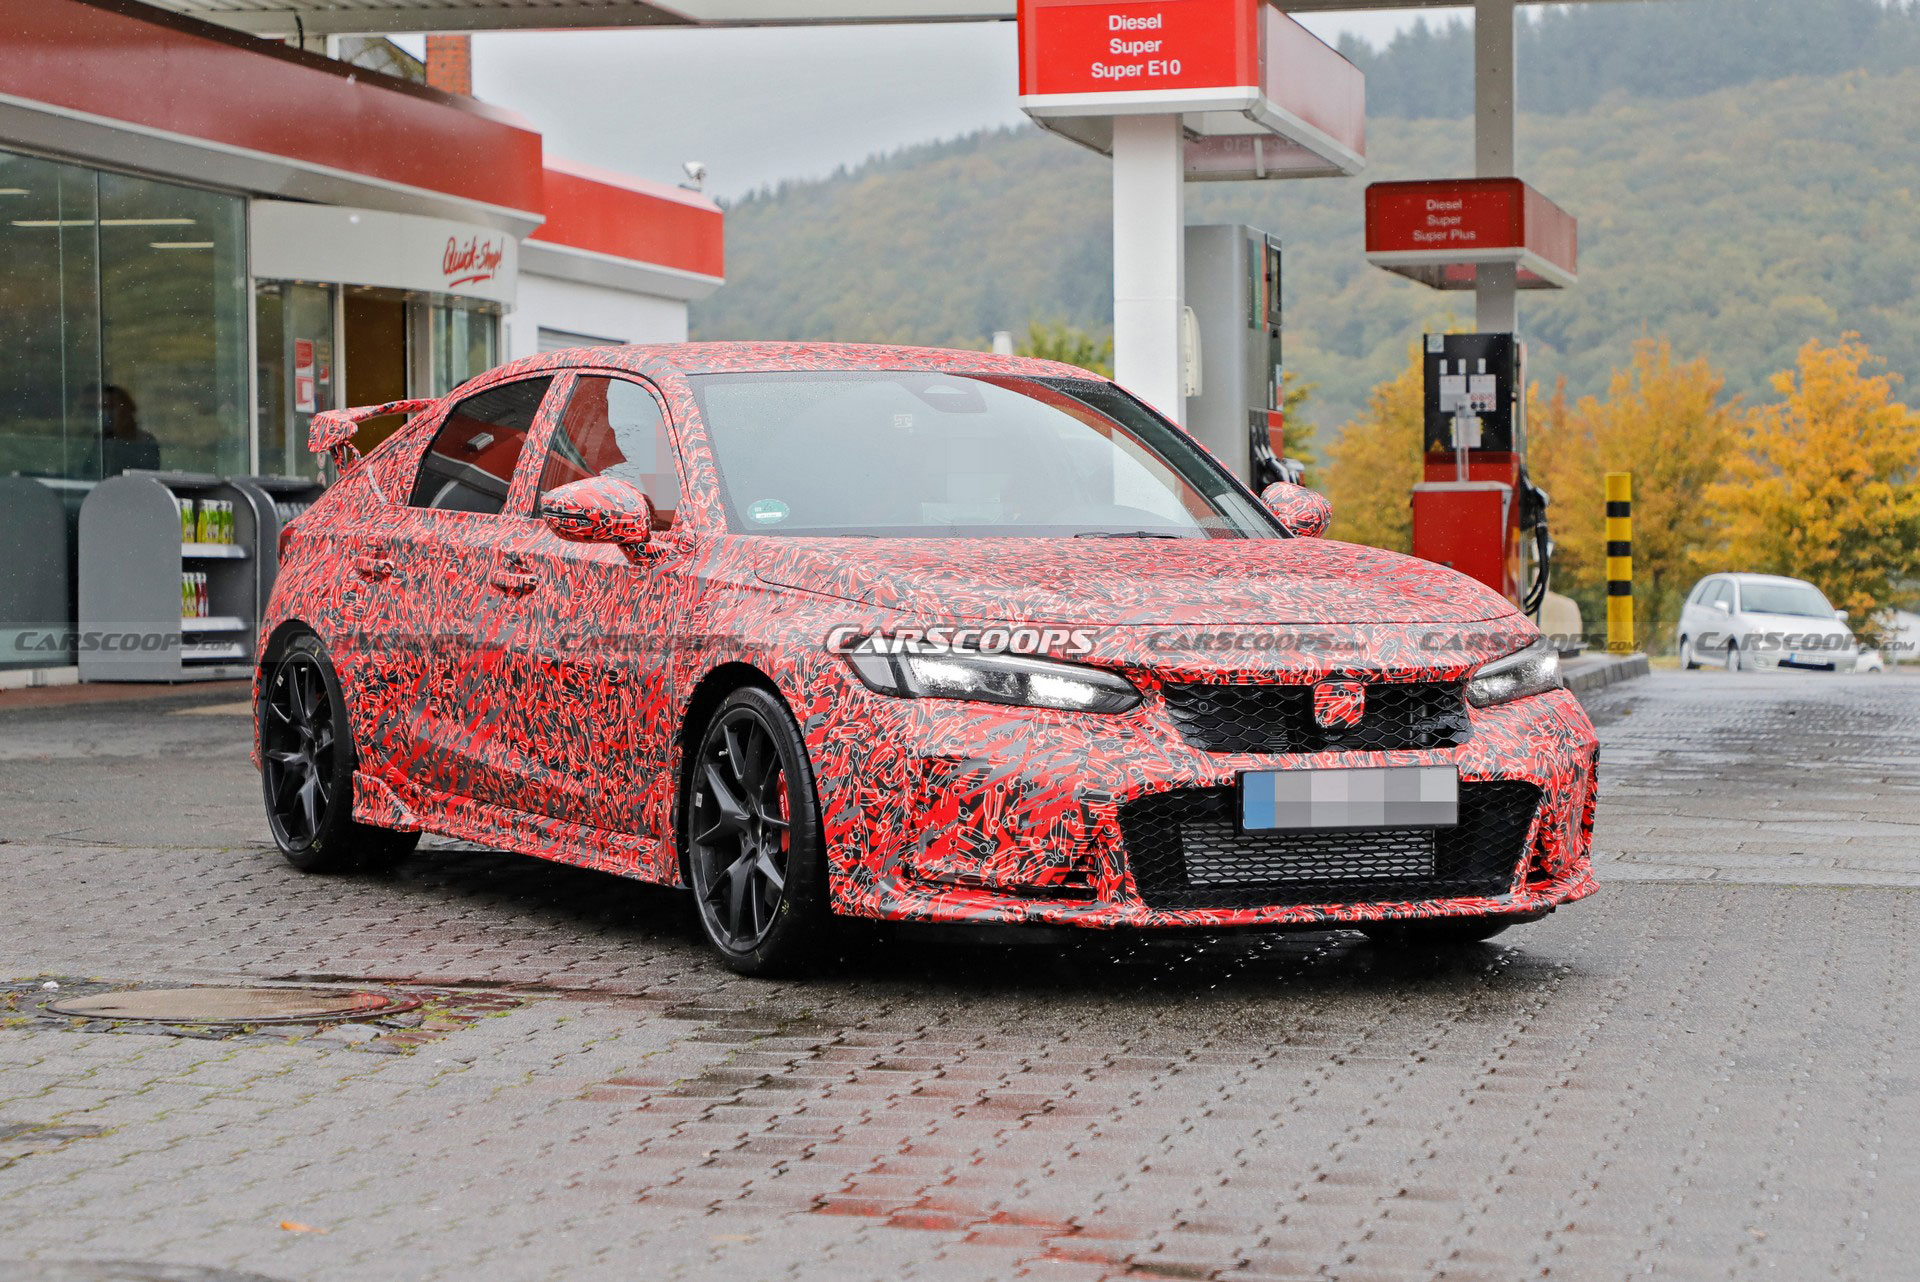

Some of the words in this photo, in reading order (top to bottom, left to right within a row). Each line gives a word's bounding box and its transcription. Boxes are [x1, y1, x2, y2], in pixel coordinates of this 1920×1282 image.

[1108, 12, 1162, 31] Diesel
[1109, 37, 1163, 57] Super
[1091, 61, 1144, 81] Super
[1147, 59, 1181, 77] E10
[1425, 198, 1463, 212] Diesel
[1426, 214, 1462, 228] Super
[1413, 229, 1447, 243] Super
[1450, 228, 1477, 241] Plus
